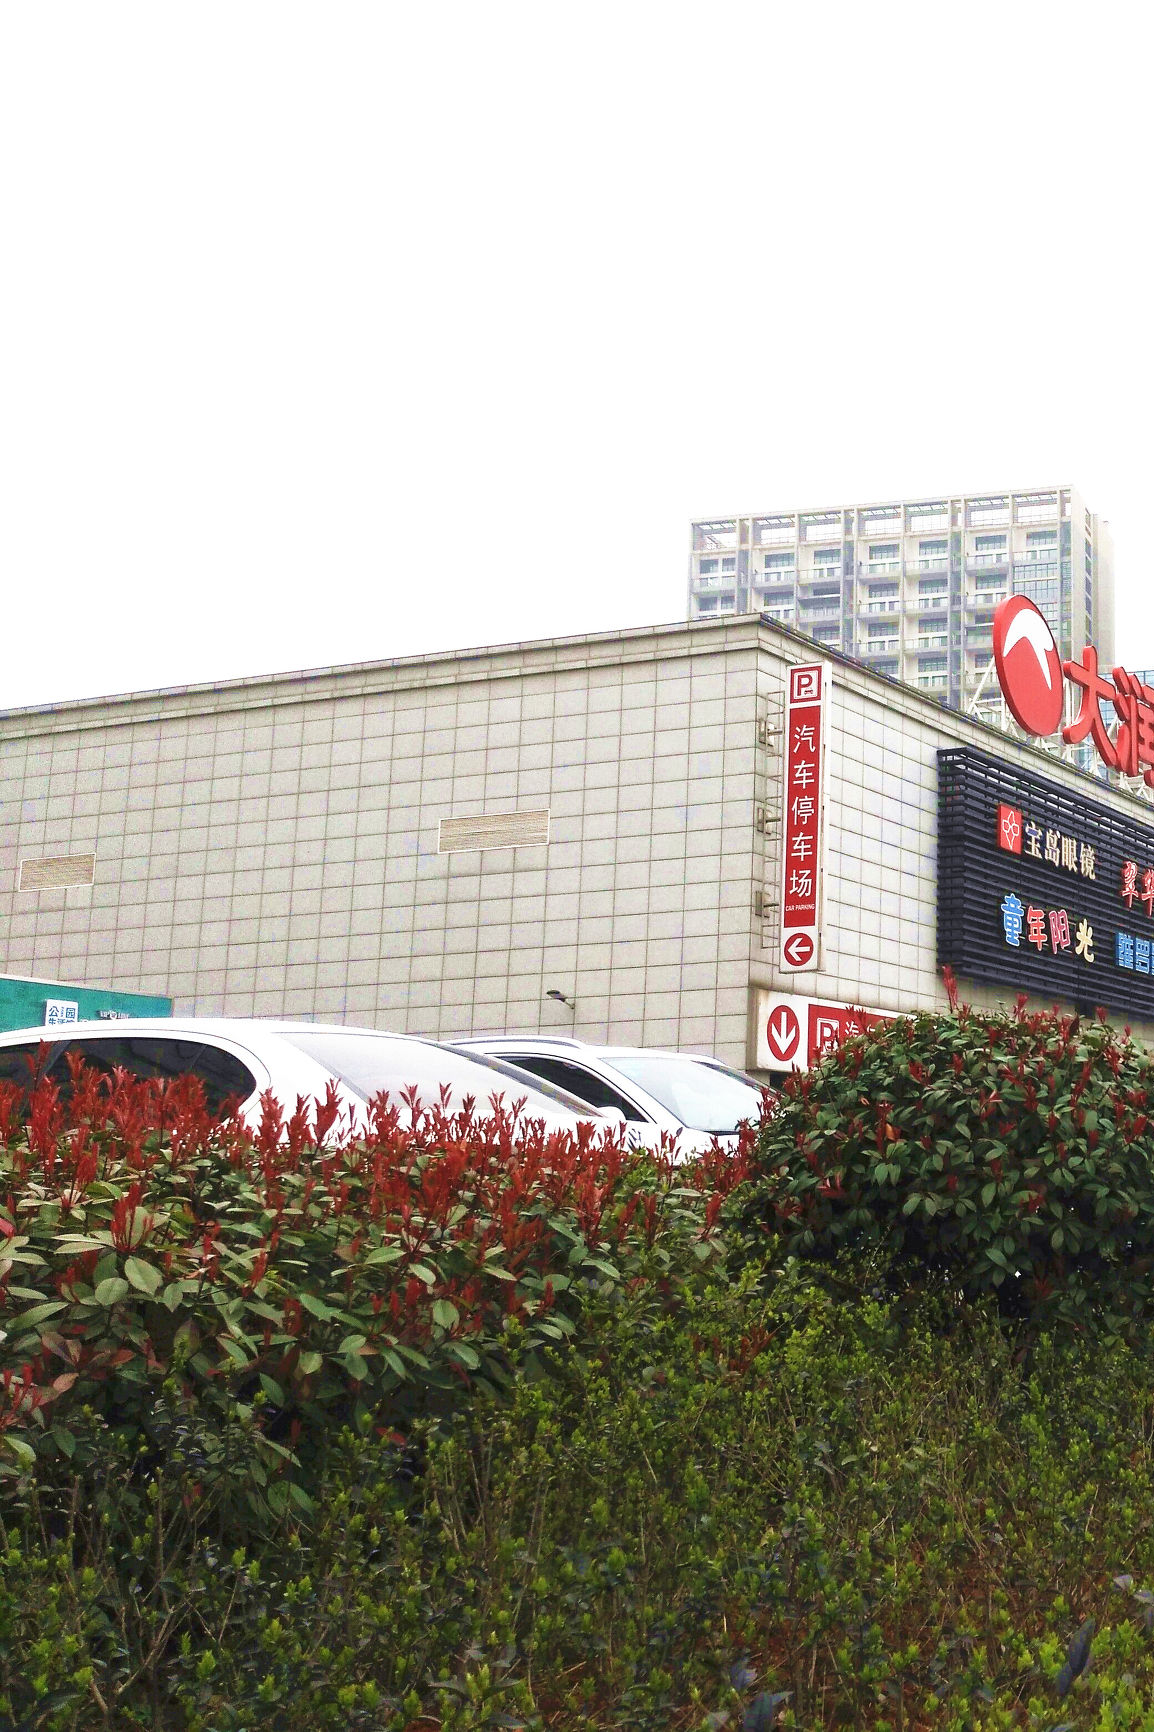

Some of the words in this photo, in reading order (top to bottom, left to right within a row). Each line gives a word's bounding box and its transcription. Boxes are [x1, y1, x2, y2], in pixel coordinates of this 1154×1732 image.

[790, 723, 816, 899] 汽车停车场
[1024, 821, 1097, 880] 宝岛眼镜
[1000, 893, 1095, 963] 童年阳光
